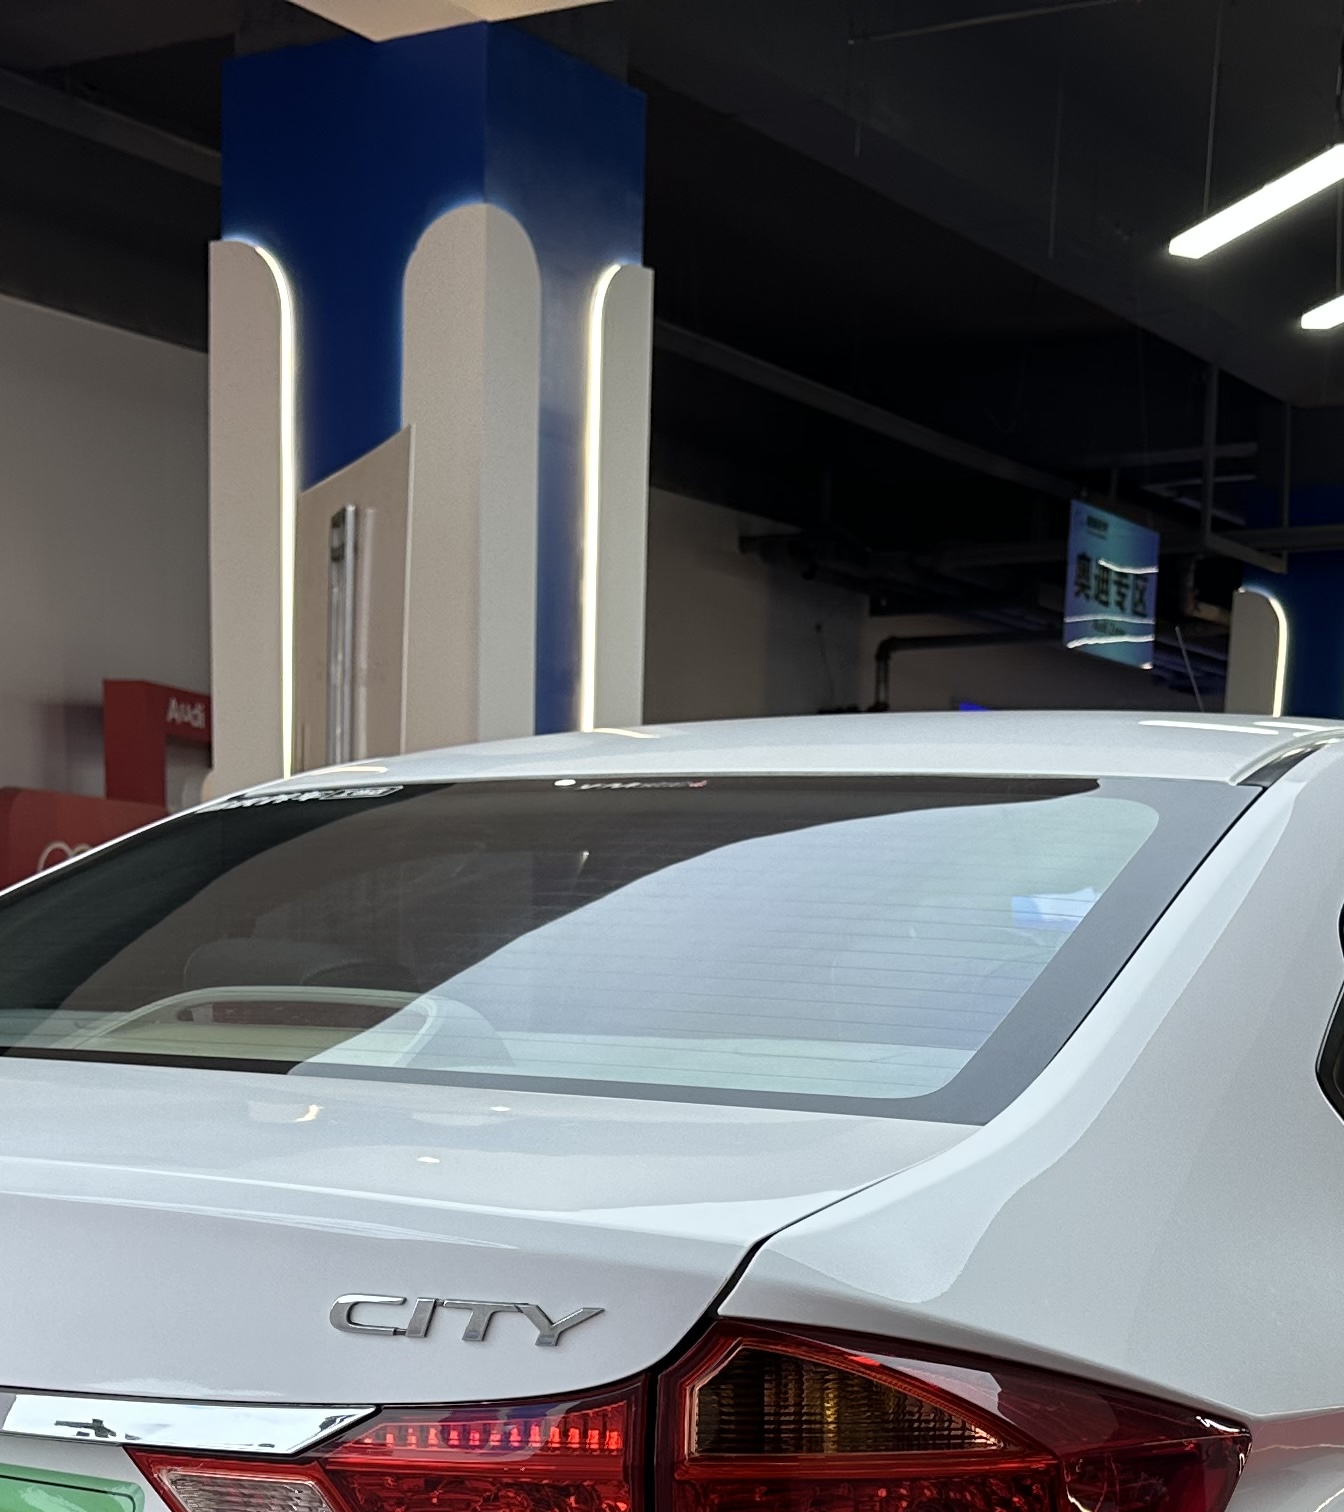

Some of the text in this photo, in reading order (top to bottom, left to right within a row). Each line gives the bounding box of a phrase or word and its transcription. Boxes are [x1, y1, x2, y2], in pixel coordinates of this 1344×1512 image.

[1075, 552, 1148, 618] 奥迪专区
[167, 697, 206, 729] Audi
[329, 1293, 605, 1346] CITY
